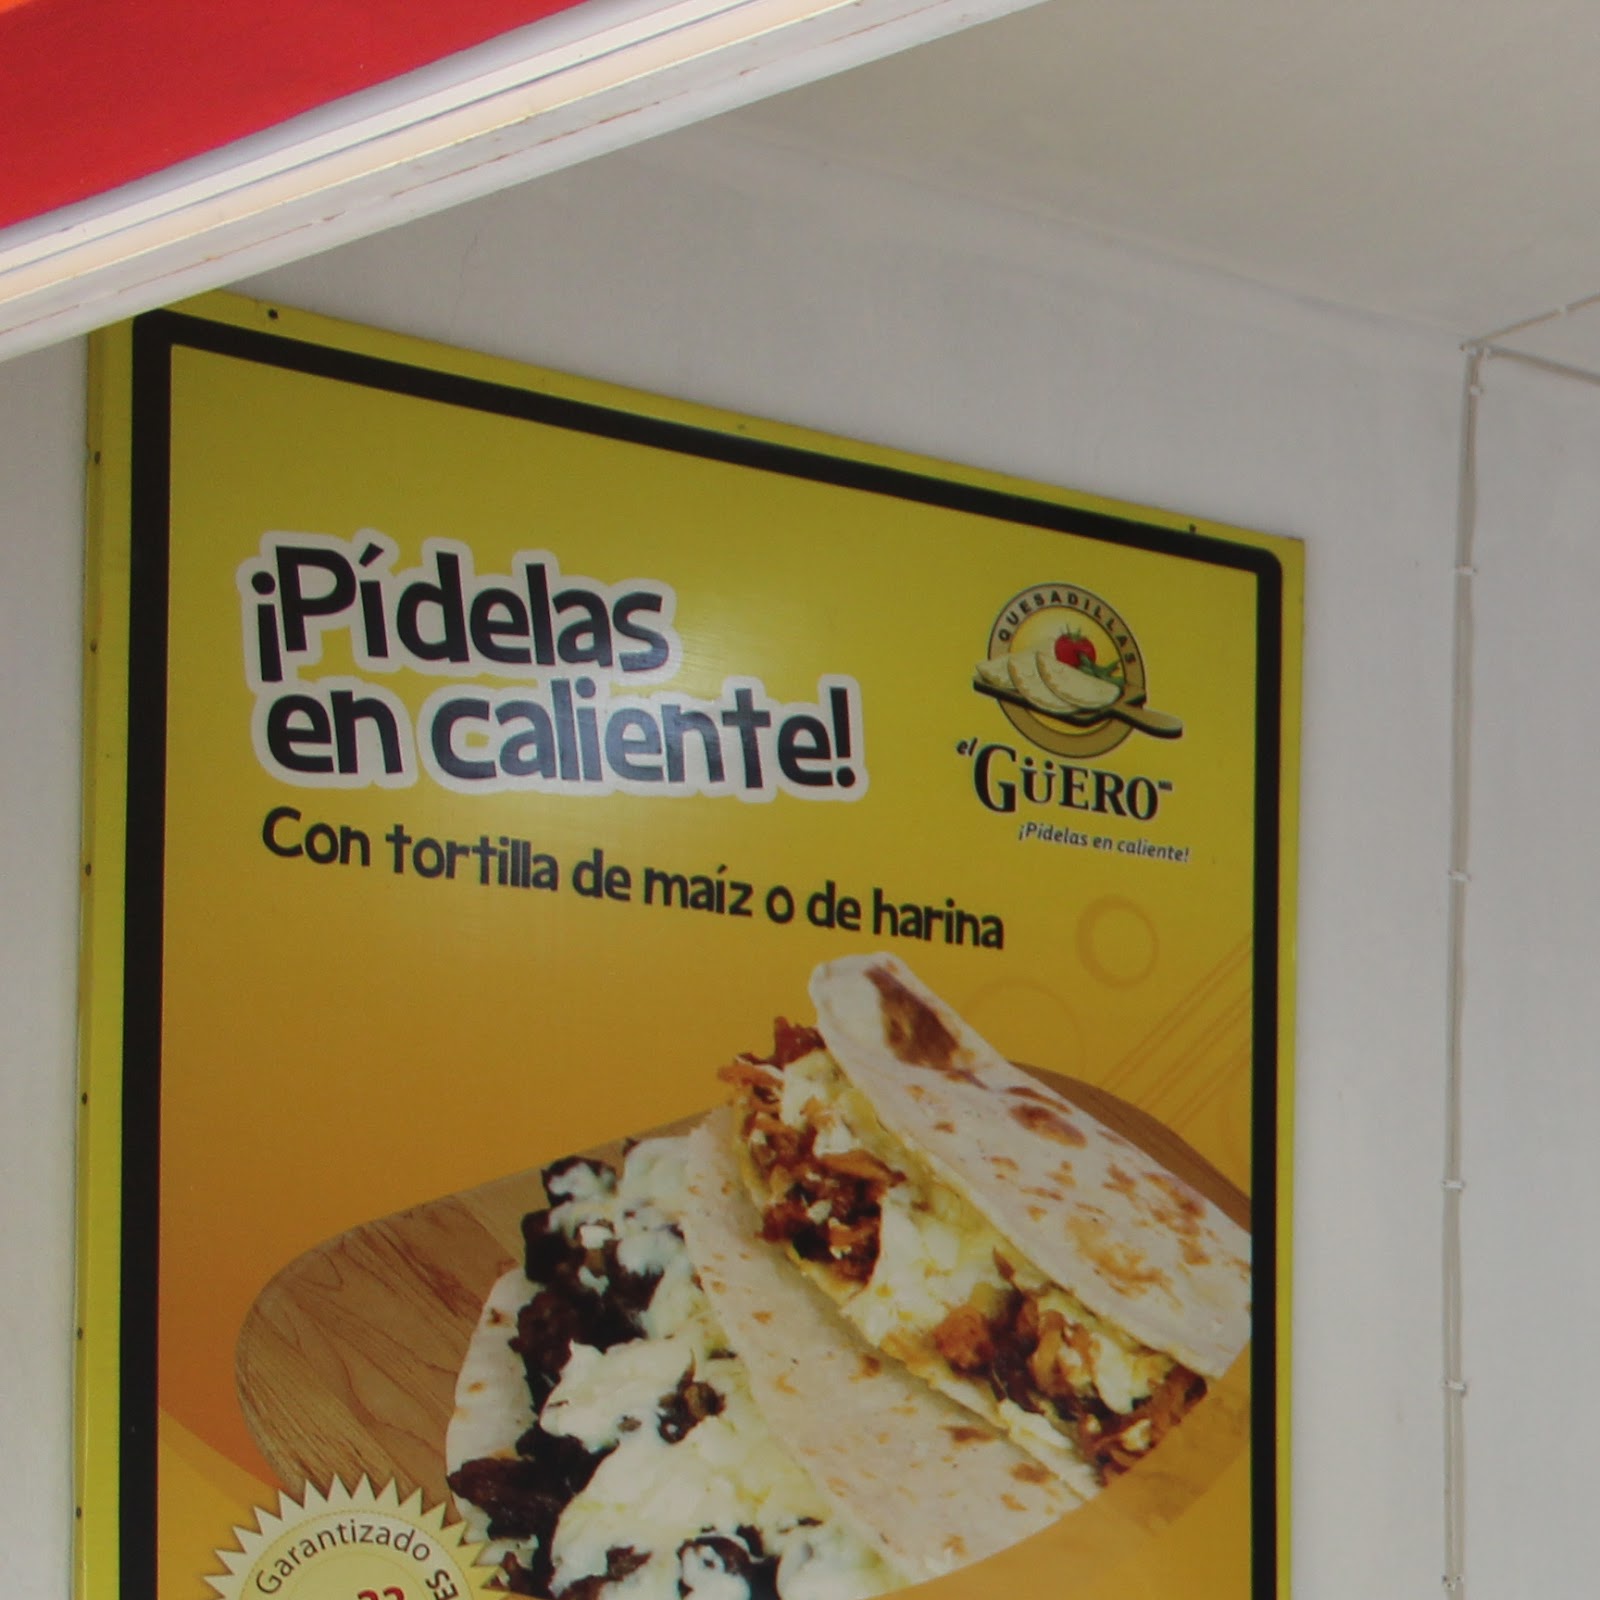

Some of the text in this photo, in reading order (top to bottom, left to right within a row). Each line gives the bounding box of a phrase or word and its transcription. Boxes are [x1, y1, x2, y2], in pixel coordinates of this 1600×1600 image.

[251, 542, 670, 683] ¡Pídelas
[997, 589, 1137, 665] QUESADILLAS
[266, 676, 857, 789] en caliente!
[956, 738, 1159, 821] el GÜERO
[262, 806, 1004, 950] Con tortilla de maíz o de harina
[1093, 836, 1113, 850] en
[1117, 838, 1190, 862] caliente!
[255, 1519, 430, 1595] Garantizado
